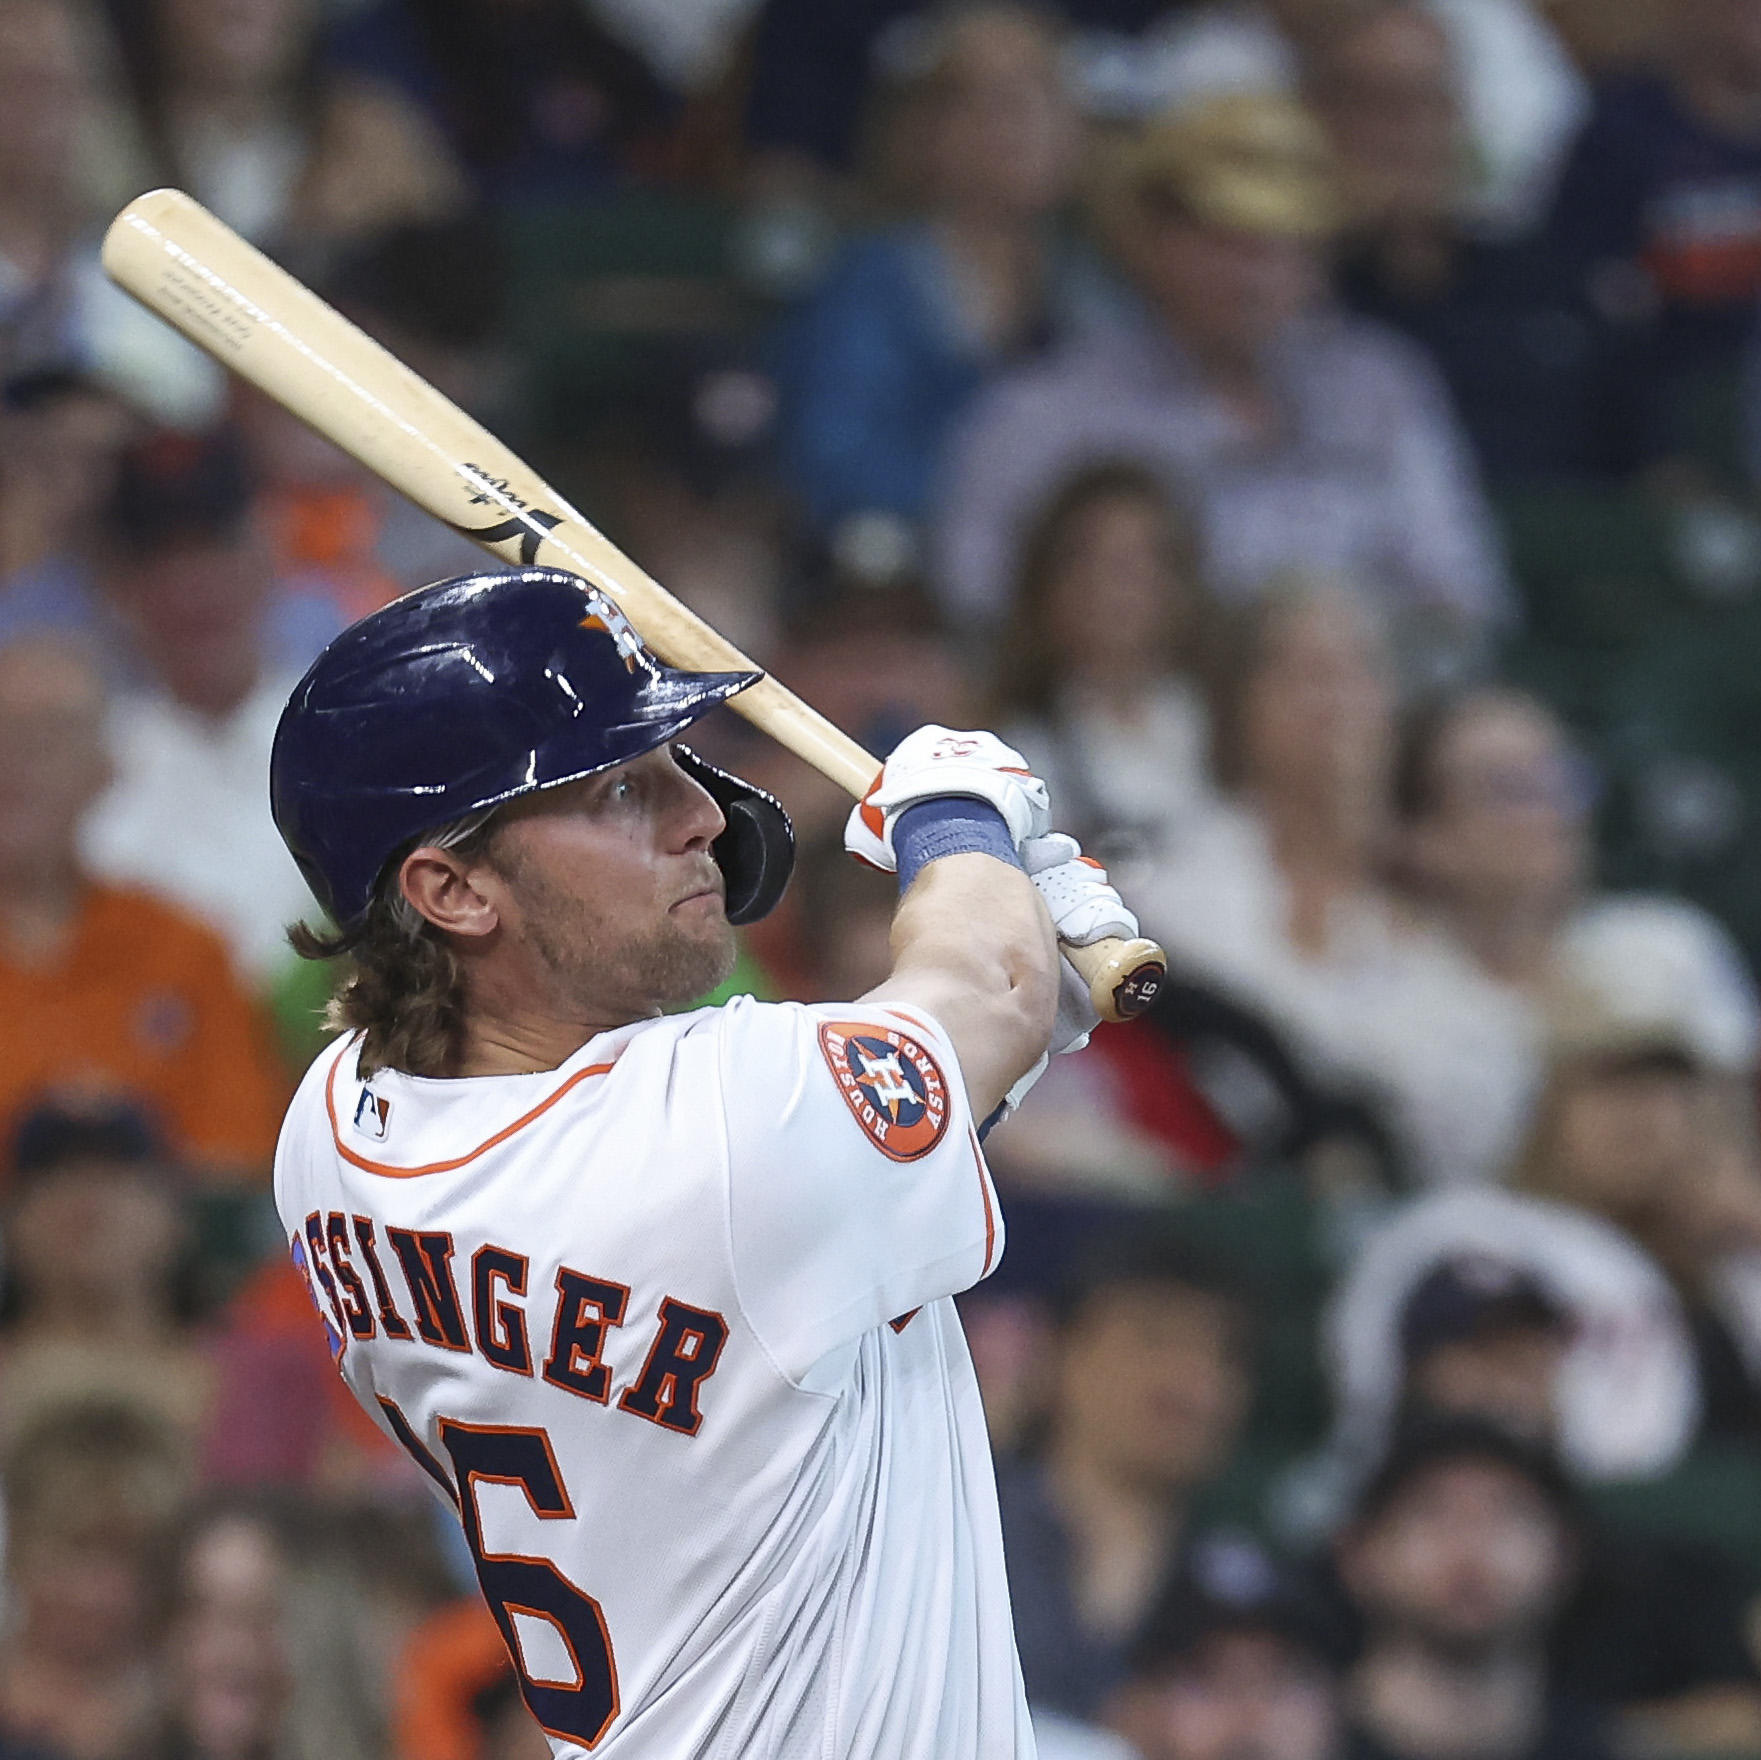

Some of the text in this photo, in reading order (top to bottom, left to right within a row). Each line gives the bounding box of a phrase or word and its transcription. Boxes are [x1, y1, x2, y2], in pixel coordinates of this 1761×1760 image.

[1137, 981, 1158, 1002] 16
[825, 1030, 890, 1143] HOUSTON
[857, 1052, 919, 1107] H
[887, 1031, 945, 1131] ASTROS
[291, 1209, 730, 1437] SSINGER
